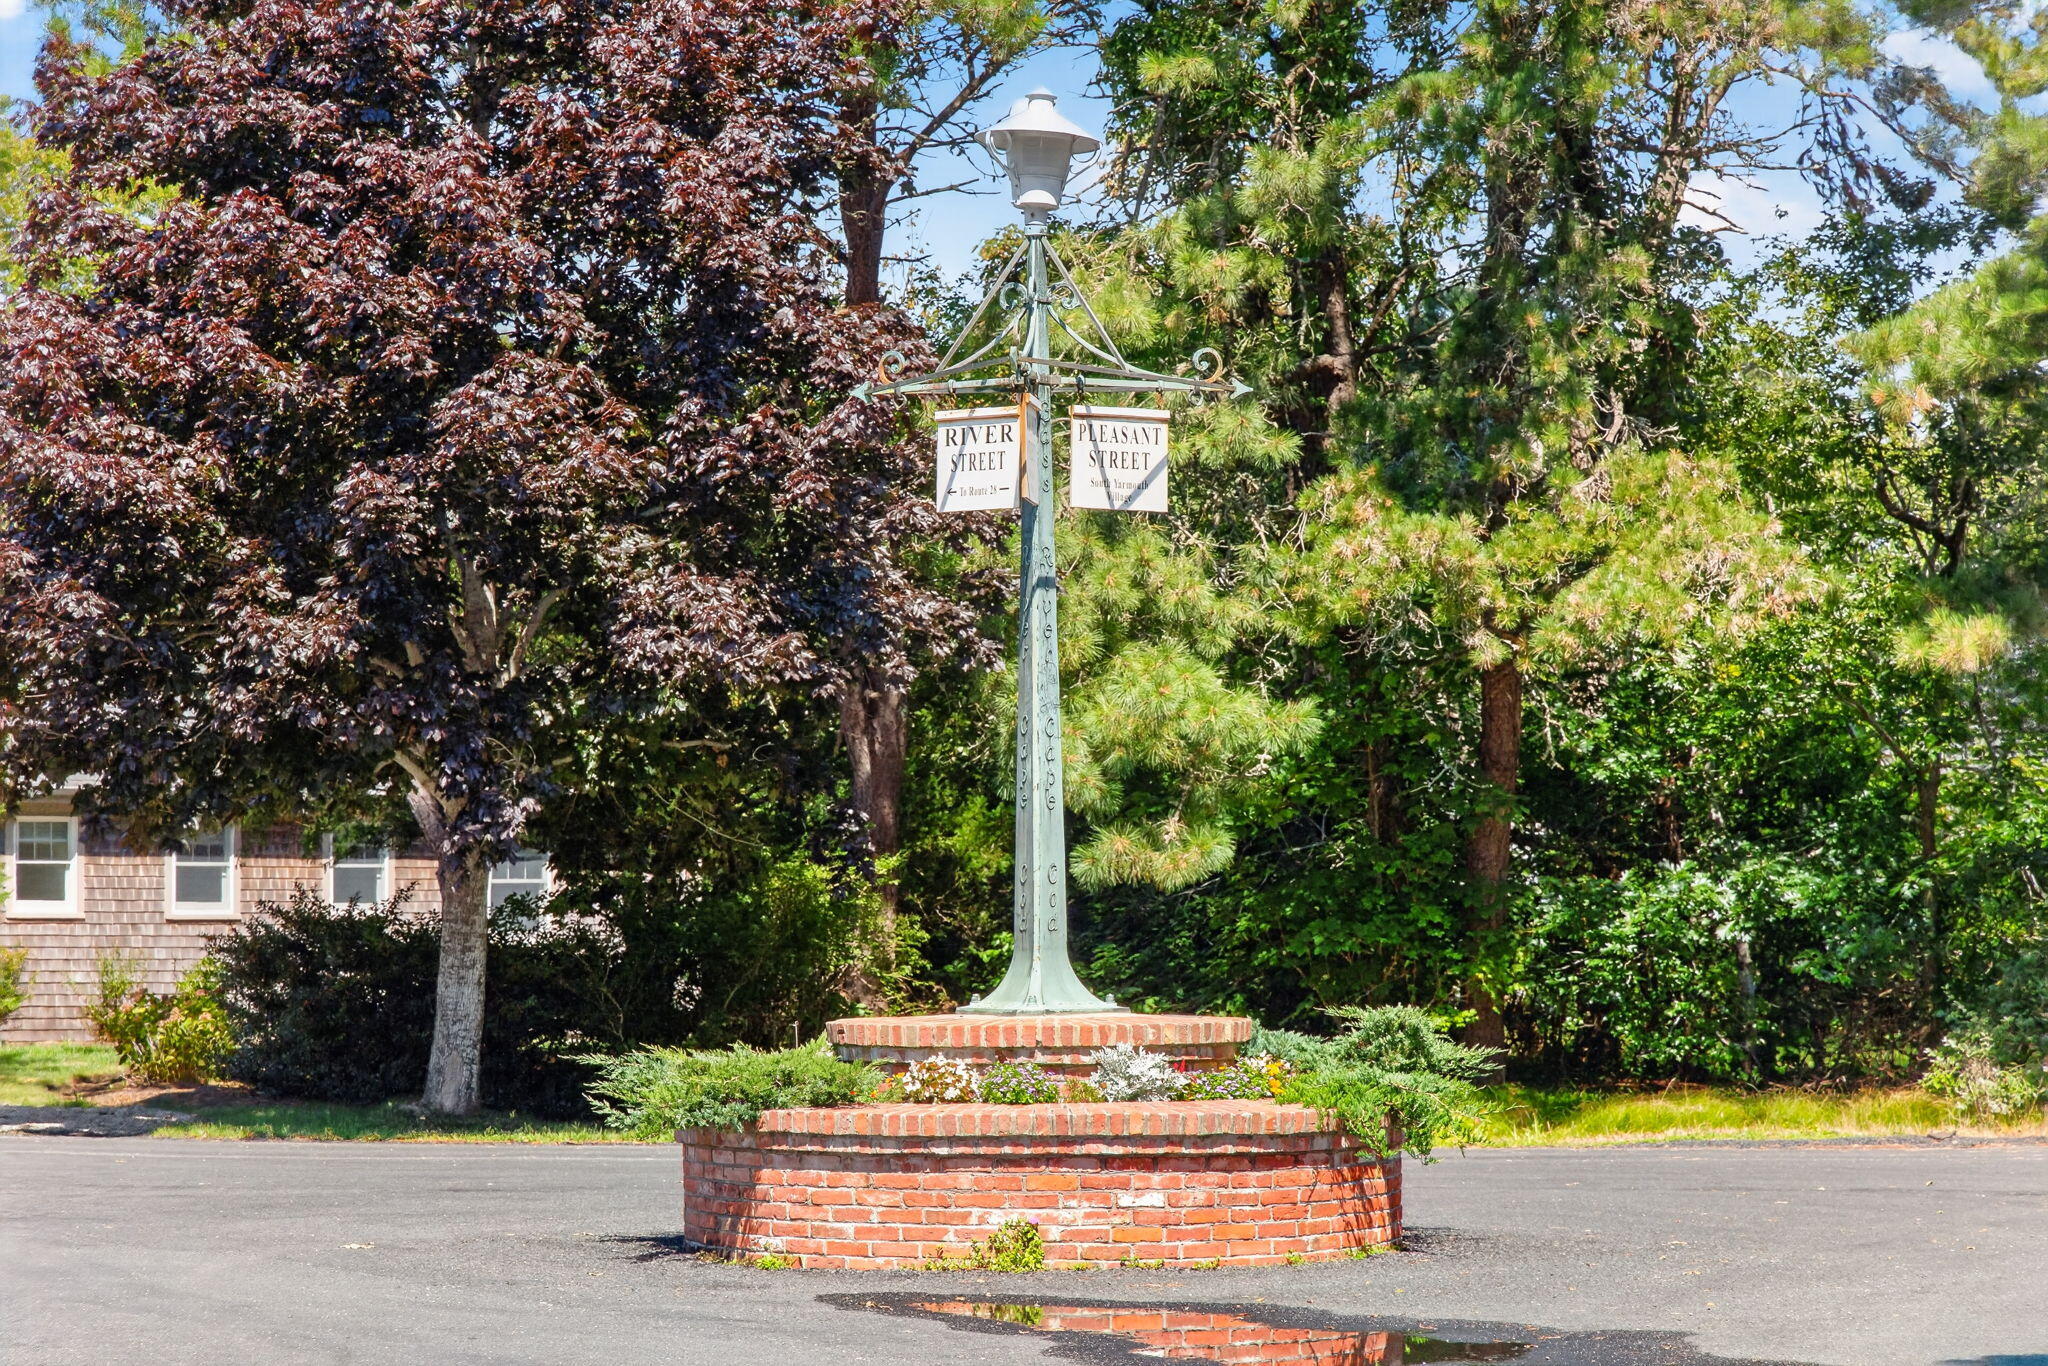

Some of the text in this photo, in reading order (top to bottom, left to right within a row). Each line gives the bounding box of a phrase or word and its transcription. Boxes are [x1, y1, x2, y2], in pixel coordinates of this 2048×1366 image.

[945, 424, 1014, 447] RIVER
[1078, 423, 1162, 446] PLEASANT
[950, 451, 1006, 473] STREET
[1088, 450, 1151, 471] STREET
[960, 487, 967, 497] To
[969, 486, 987, 497] Route
[1090, 477, 1149, 490] South Yarmouth
[1107, 491, 1133, 504] Village
[1045, 716, 1055, 811] Cape
[1047, 863, 1058, 932] Cod
